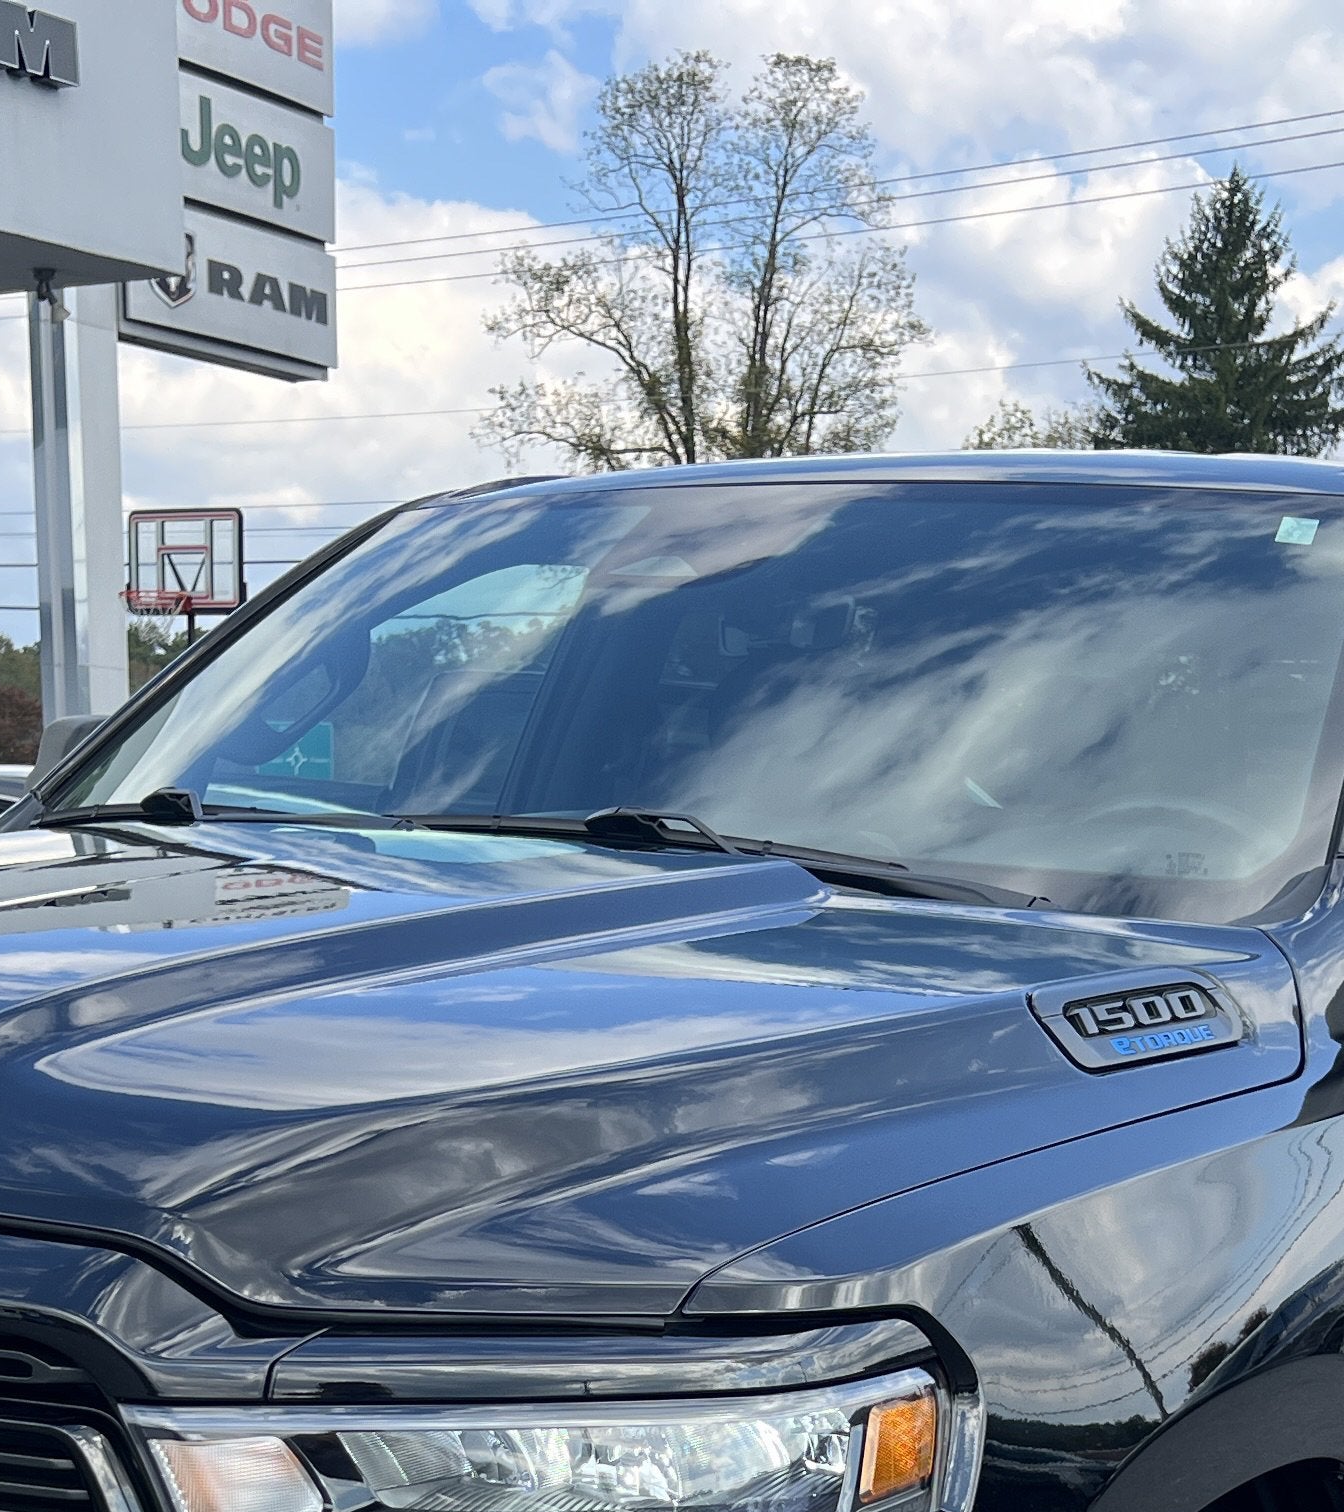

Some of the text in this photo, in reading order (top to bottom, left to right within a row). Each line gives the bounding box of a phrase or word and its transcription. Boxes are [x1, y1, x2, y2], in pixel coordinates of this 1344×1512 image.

[180, 95, 301, 209] Jeep
[207, 258, 328, 326] RAM
[1066, 989, 1207, 1035] 1500
